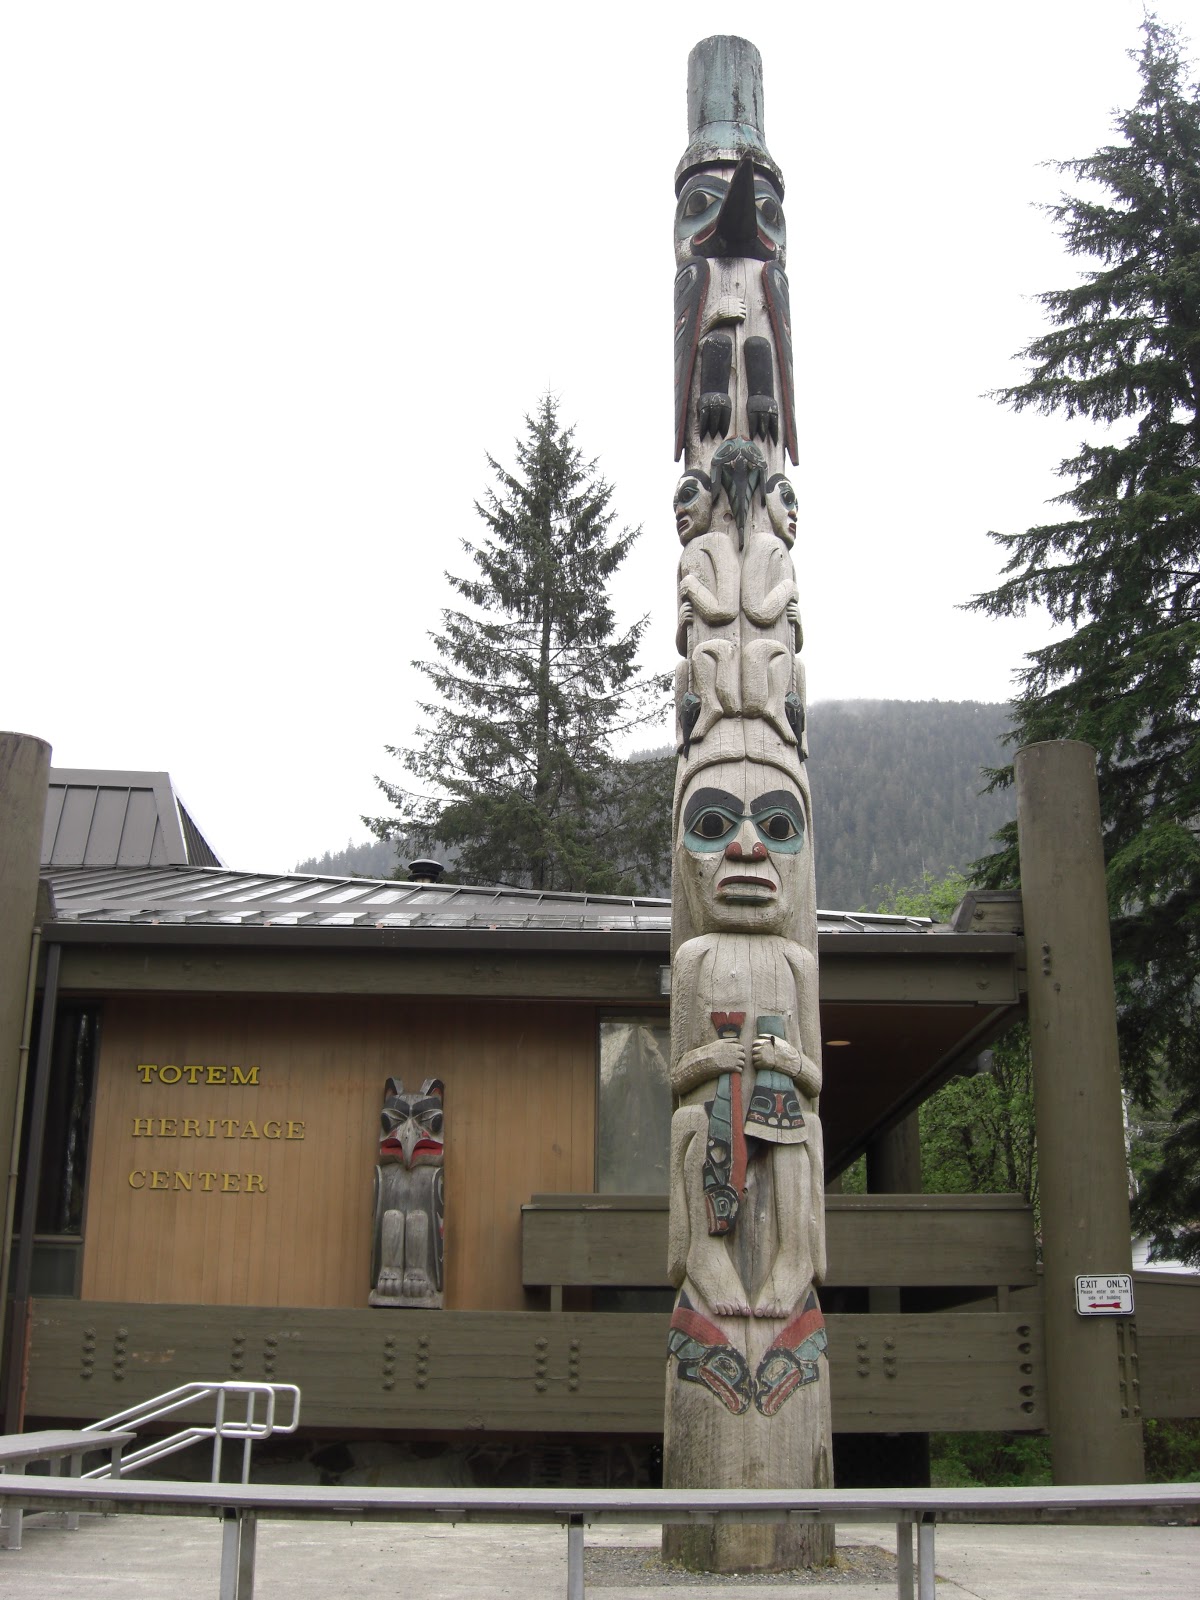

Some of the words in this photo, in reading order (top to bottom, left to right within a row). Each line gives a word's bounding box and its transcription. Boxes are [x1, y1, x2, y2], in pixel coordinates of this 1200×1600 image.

[137, 1064, 260, 1085] TOTEM
[132, 1118, 305, 1140] HERITAGE
[128, 1170, 267, 1193] CENTER
[1080, 1280, 1097, 1288] EXIT
[1106, 1280, 1128, 1288] ONLY
